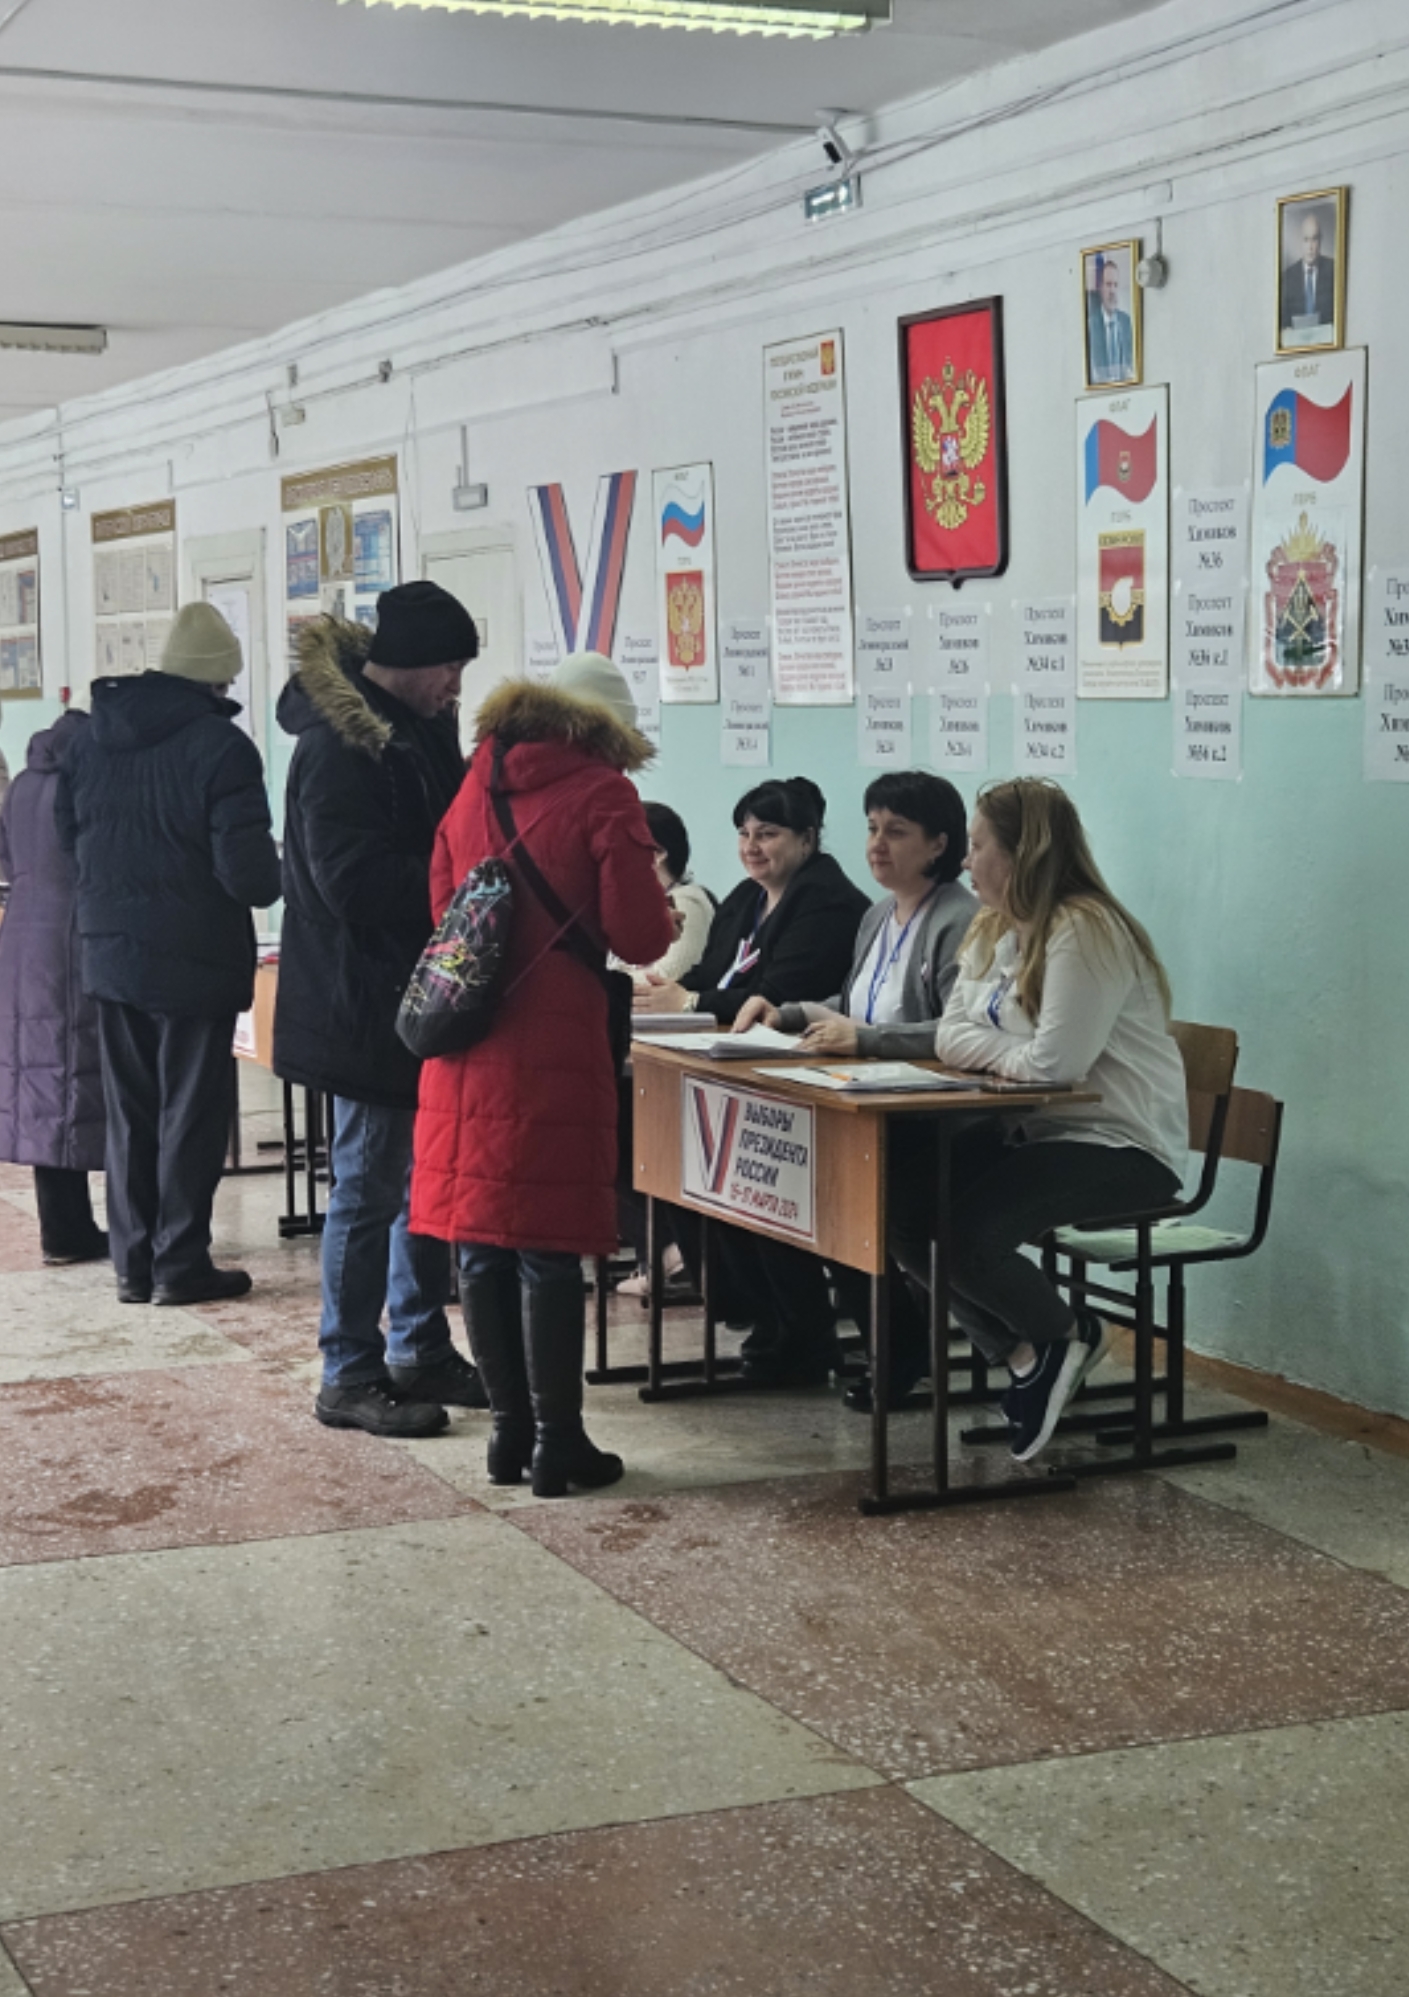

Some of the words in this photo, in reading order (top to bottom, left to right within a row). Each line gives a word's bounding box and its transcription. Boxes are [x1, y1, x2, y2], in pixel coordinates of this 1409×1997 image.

[1188, 497, 1234, 518] Проспект
[1187, 524, 1238, 542] Химиков
[1188, 594, 1233, 614] Проспект
[1185, 620, 1234, 638] Химиков
[744, 1102, 795, 1132] ВЫБОРЫ
[738, 1128, 808, 1168] ПРЕЗИДЕНТА
[734, 1156, 779, 1187] РОССИИ
[752, 1190, 777, 1214] МАРТА
[777, 1197, 798, 1221] 2024
